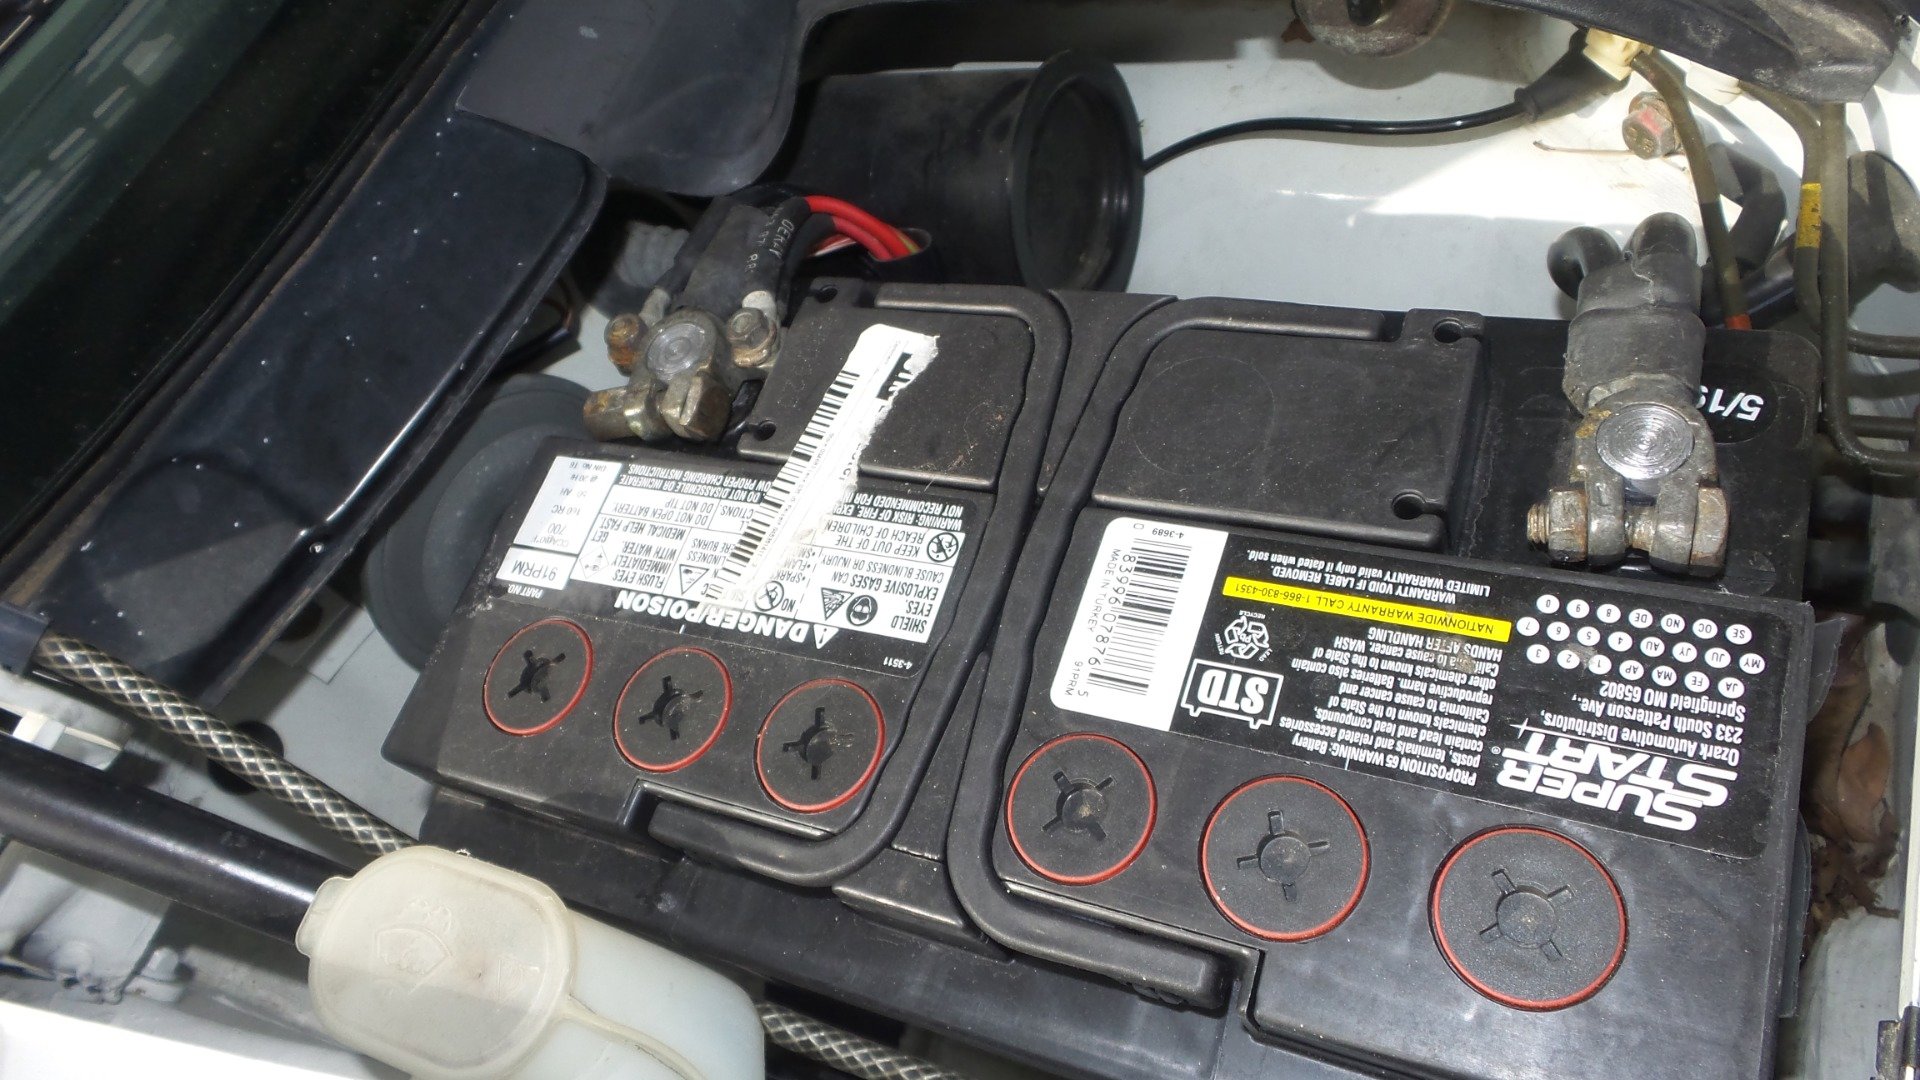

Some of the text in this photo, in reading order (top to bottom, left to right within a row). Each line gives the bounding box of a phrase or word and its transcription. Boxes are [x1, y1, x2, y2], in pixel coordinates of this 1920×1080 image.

[627, 463, 683, 480] INSTRUCTIONS.
[681, 471, 724, 485] CHARGING
[617, 474, 663, 489] INCINERATE.
[673, 481, 730, 498] DISASSEMBLE
[721, 475, 756, 490] PROPER
[680, 499, 699, 511] NOT
[852, 492, 873, 505] FOR
[872, 494, 942, 515] RECOMMENDED
[649, 507, 674, 520] OPEN
[674, 511, 694, 523] NOT
[877, 508, 892, 520] OF
[891, 510, 915, 524] RISK
[941, 504, 963, 518] NOT
[546, 522, 567, 535] 700
[622, 520, 646, 534] HELP
[914, 513, 962, 530] WARNING:
[591, 529, 609, 543] GET
[646, 523, 686, 540] MEDICAL
[874, 526, 890, 539] OF
[890, 528, 925, 544] REACH
[1151, 527, 1184, 539] 4-3689
[652, 546, 677, 561] WITH
[834, 534, 920, 557] KEEP OUT OF THE
[1104, 547, 1121, 575] MADE
[1246, 548, 1269, 561] sold.
[1269, 552, 1296, 565] when
[1297, 556, 1325, 570] dated
[510, 560, 558, 581] 91PRM
[612, 553, 671, 574] IMMEDIATELY
[865, 560, 913, 577] BLINDNESS
[1334, 560, 1357, 575] only
[1357, 565, 1383, 579] valid
[611, 568, 665, 588] FLUSH EYES
[914, 568, 944, 583] CAUSE
[1270, 564, 1322, 583] REMOVED.
[1323, 572, 1354, 588] LABEL
[1383, 569, 1444, 589] WARRANTY
[519, 586, 543, 598] PART
[830, 570, 939, 601] EXPLOSIVE GASES CAN
[1367, 579, 1393, 594] VOID
[1394, 584, 1456, 604] WARRANTY
[1445, 578, 1490, 596] LIMITED
[780, 597, 796, 612] NO
[904, 599, 933, 617] EYES.
[1086, 592, 1106, 632] TURKEY
[1087, 553, 1136, 666] 83996 07876
[1234, 582, 1493, 634] NATIONWIDE WARRANTY CALL 1-866-830-4351
[614, 588, 810, 643] DANGER/POISON
[889, 614, 927, 634] SHIELD
[1332, 635, 1366, 653] WASH
[1366, 626, 1502, 662] HANDS AFTER HANDLING
[1368, 641, 1404, 657] cancer.
[882, 656, 912, 670] 4-3511
[1404, 647, 1435, 663] cause
[1311, 646, 1496, 692] other chemicals known to the State of
[1656, 669, 1672, 681] MA
[1064, 660, 1083, 696] 91PRM
[1290, 657, 1493, 705] reproductive harm. Batteries also contain
[1196, 668, 1269, 715] STD
[1337, 681, 1489, 723] California to cause cancer and
[1598, 679, 1745, 723] Springfield MO 65802
[1326, 694, 1486, 738] chemicals known to the State of
[1605, 701, 1670, 730] Patterson
[1313, 705, 1483, 752] contain lead and lead compounds,
[1672, 715, 1712, 738] South
[1715, 722, 1743, 744] 233
[1278, 715, 1480, 768] posts, terminals and related accessories
[1539, 708, 1739, 766] Ozark Automotive Distributors,
[1290, 731, 1477, 786] PROPOSITION 65 WARNING: Battery
[1501, 732, 1738, 807] START
[1496, 759, 1703, 831] SUPER
